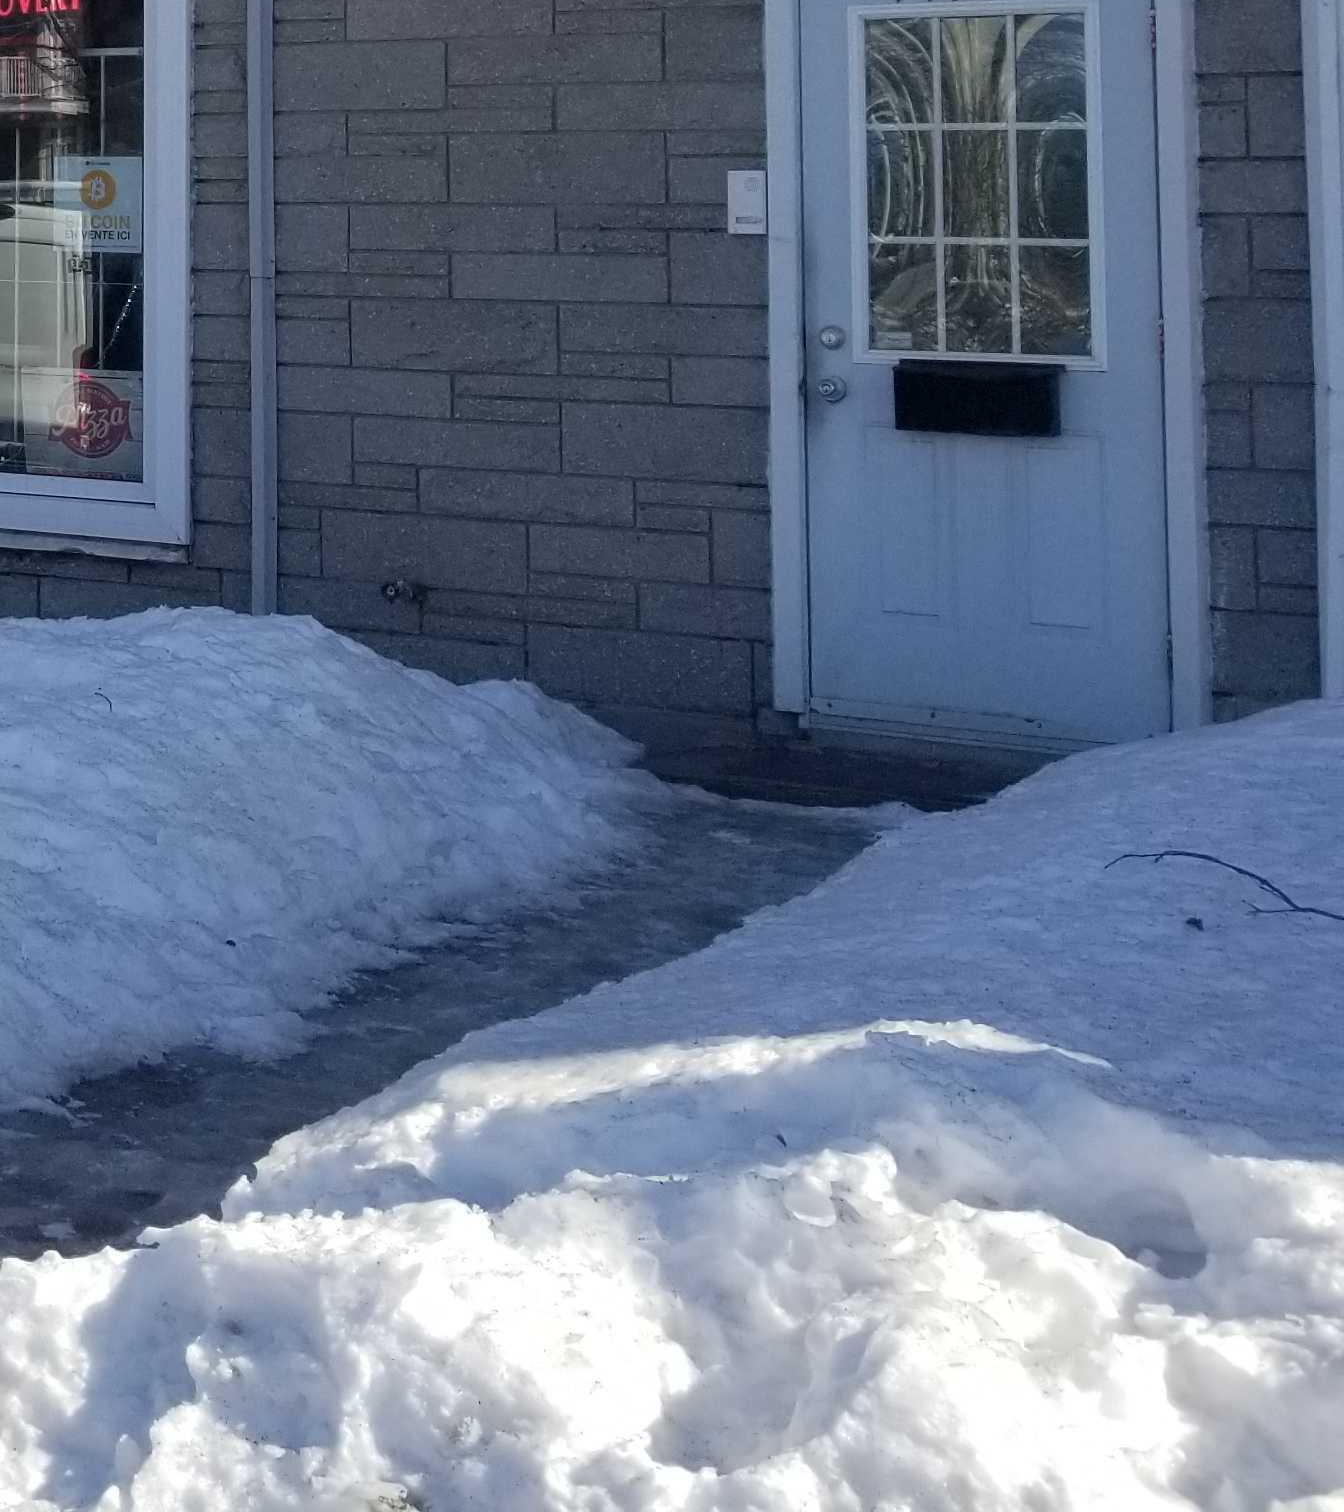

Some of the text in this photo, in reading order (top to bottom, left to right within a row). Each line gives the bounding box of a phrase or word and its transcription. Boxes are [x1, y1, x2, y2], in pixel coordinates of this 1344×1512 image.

[65, 215, 130, 230] BTCOIN
[81, 230, 115, 241] VENTE
[117, 231, 131, 241] ICI
